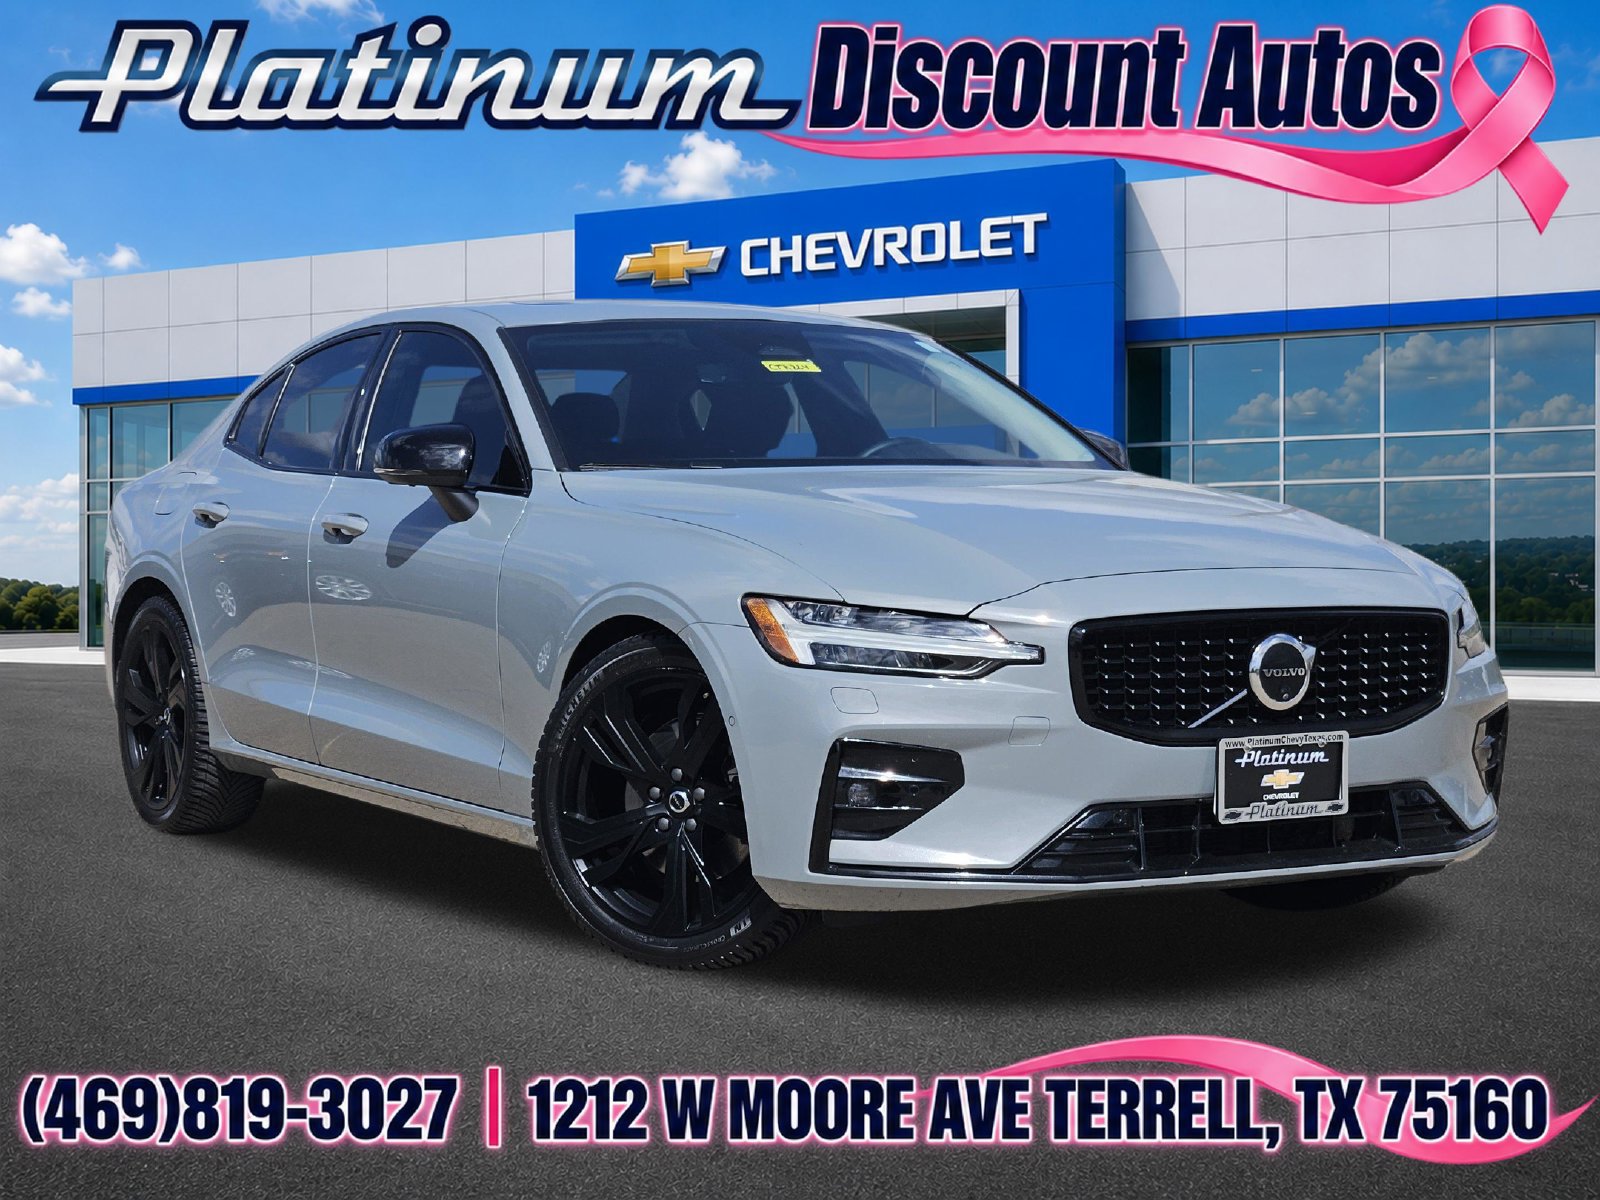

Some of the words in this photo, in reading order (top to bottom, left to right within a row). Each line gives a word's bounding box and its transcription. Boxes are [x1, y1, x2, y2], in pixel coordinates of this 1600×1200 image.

[740, 212, 1048, 277] CHEVROLET
[1262, 667, 1306, 678] VOLVO
[1224, 733, 1343, 747] www.PlatinumChevyTexas.com
[1234, 748, 1330, 768] Platinum
[1263, 791, 1300, 801] CHEVROLET
[1245, 801, 1323, 820] Platinum
